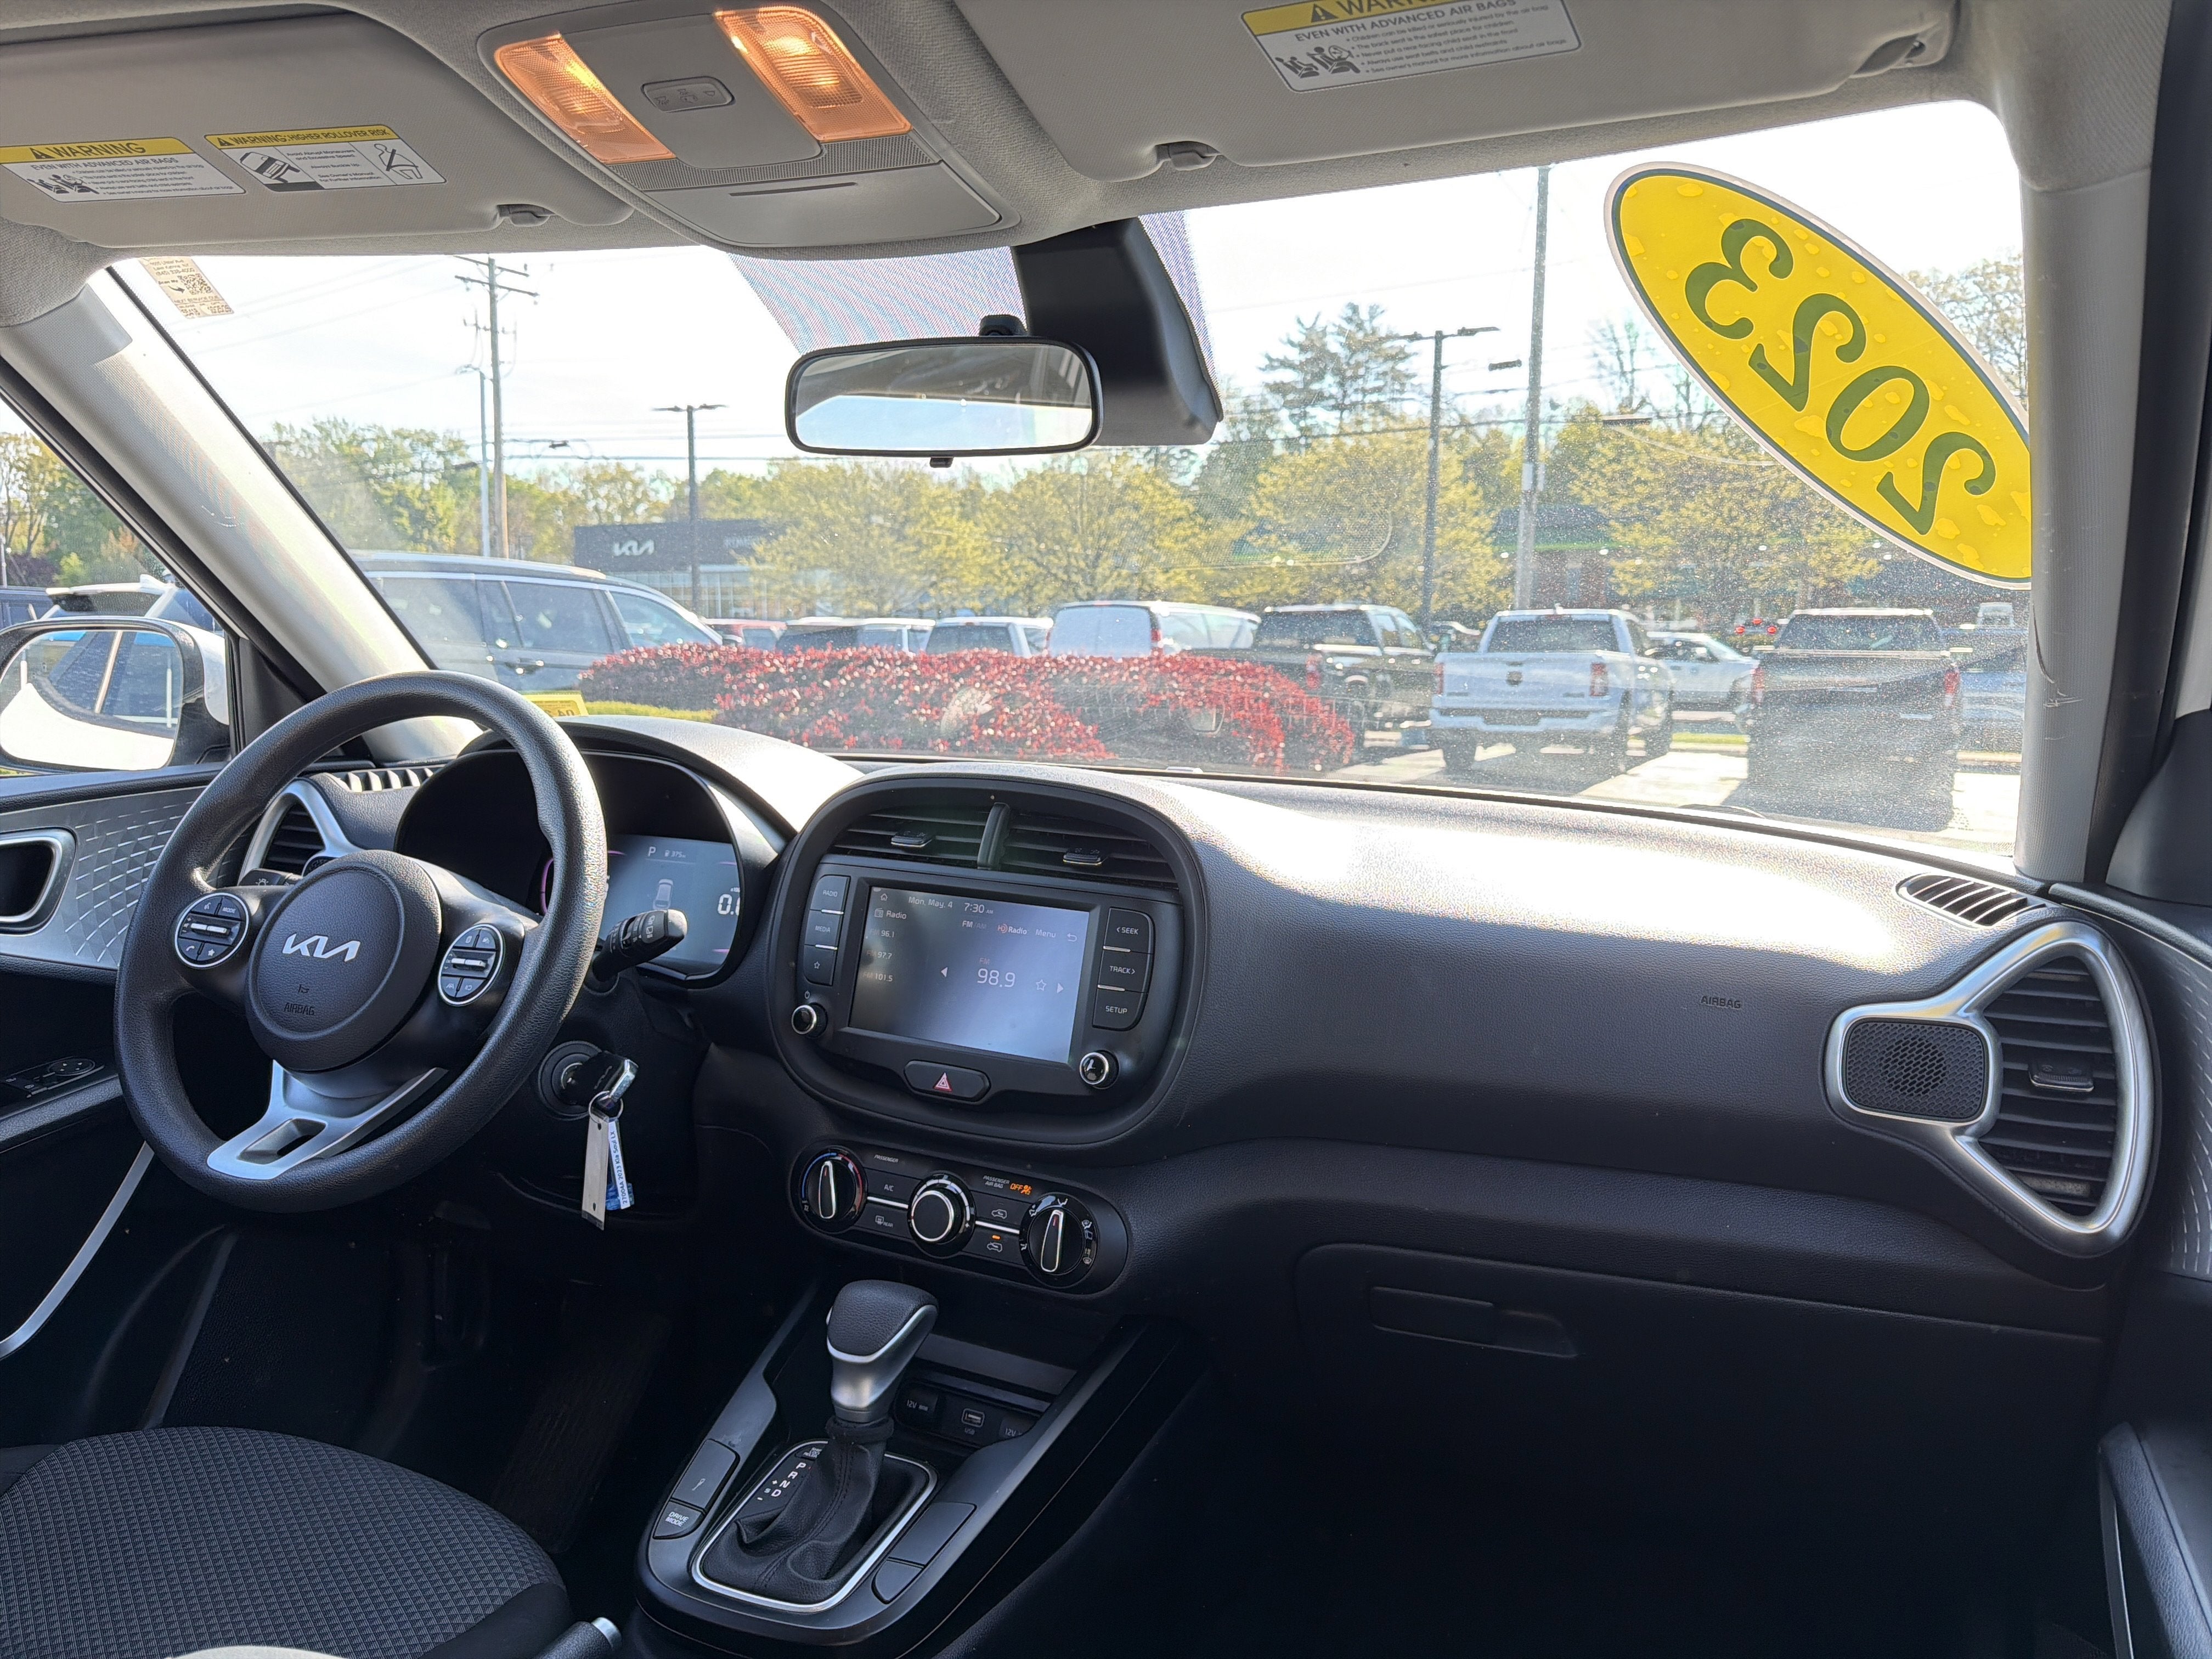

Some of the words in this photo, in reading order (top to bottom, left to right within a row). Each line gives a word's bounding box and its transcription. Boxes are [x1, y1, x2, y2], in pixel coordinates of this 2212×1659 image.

[1295, 30, 1330, 41] EVEN
[1331, 23, 1367, 34] WITH
[1371, 10, 1445, 30] ADVANCED
[1450, 4, 1472, 16] AIR
[1476, 0, 1516, 11] BAGS
[1436, 19, 1466, 28] seriously
[1532, 4, 1548, 13] bag
[1484, 20, 1514, 29] children
[1412, 59, 1438, 67] manual
[1470, 48, 1511, 58] information
[1512, 43, 1534, 52] about
[1367, 58, 1391, 66] Always
[290, 131, 321, 141] HIGHER
[323, 129, 369, 139] ROLLOVER
[370, 128, 391, 137] RISK
[45, 143, 146, 157] WARNING
[613, 539, 655, 557] KIA
[648, 846, 656, 857] P
[718, 894, 740, 916] 0.
[928, 899, 946, 909] May.
[964, 902, 985, 913] 7:30
[886, 910, 907, 919] Radio
[815, 925, 831, 933] MEDIA
[881, 929, 895, 938] 96.1
[1008, 926, 1028, 935] Radio
[1036, 928, 1056, 938] Menu
[282, 933, 361, 962] KIA
[877, 951, 893, 960] 97.7
[875, 973, 893, 982] 101.5
[977, 968, 1015, 988] 98.9
[1701, 995, 1742, 1009] AIRBAG
[284, 1002, 315, 1015] AIRBAG
[1105, 1005, 1127, 1014] SETUP
[874, 1154, 899, 1163] PASSENGER
[983, 1175, 1010, 1184] PASSENGER
[1010, 1183, 1023, 1191] OFF
[906, 1399, 917, 1409] 12V
[1005, 1428, 1016, 1436] 12V
[787, 1471, 798, 1480] R
[779, 1480, 791, 1488] N
[771, 1489, 782, 1497] D
[665, 1516, 685, 1527] MODE
[668, 1511, 689, 1522] DRIVE
